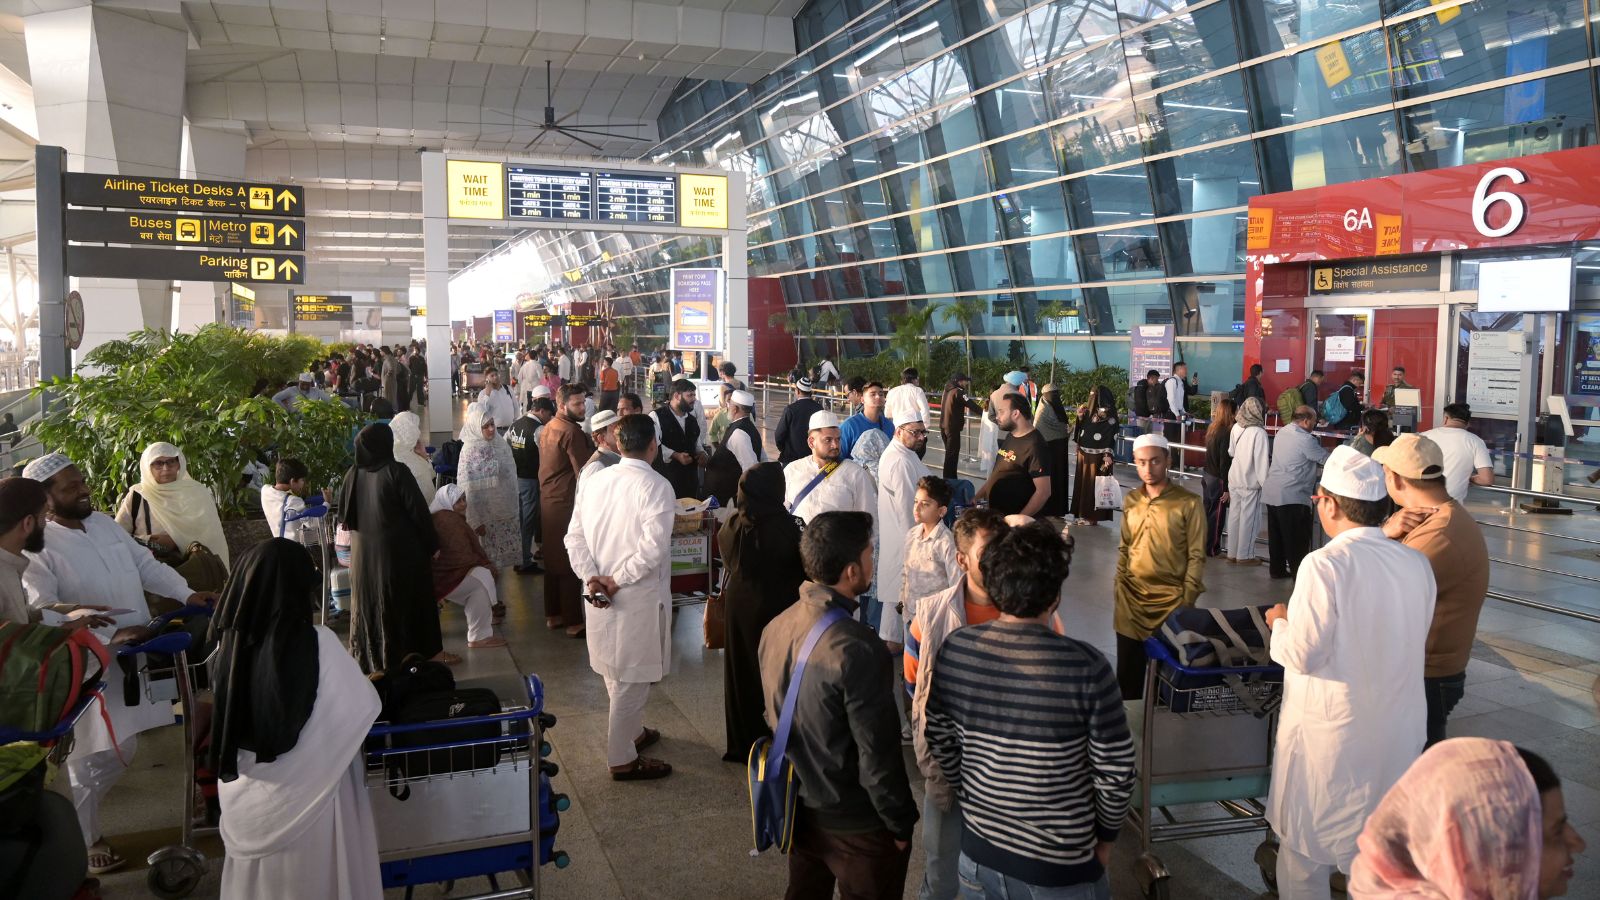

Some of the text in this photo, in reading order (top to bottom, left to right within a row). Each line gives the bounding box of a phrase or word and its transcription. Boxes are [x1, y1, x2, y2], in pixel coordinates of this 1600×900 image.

[463, 174, 488, 184] WAIT
[104, 178, 246, 197] Airline Ticket Desks A
[464, 187, 488, 196] TIME
[694, 187, 715, 196] WAIT
[526, 191, 540, 199] min
[139, 196, 177, 206] एयरलाइन
[181, 196, 204, 206] टिकट
[208, 198, 226, 208] डेस्क
[694, 198, 715, 208] TIME
[1472, 166, 1528, 238] 6
[130, 216, 172, 229] Buses
[1343, 207, 1373, 232] 6A
[209, 220, 247, 232] Metro
[140, 231, 173, 241] बस सेवा
[200, 255, 269, 275] Parking P
[1333, 262, 1428, 280] Special Assistance
[1333, 280, 1374, 290] विशेष सहायता
[694, 334, 704, 344] T3
